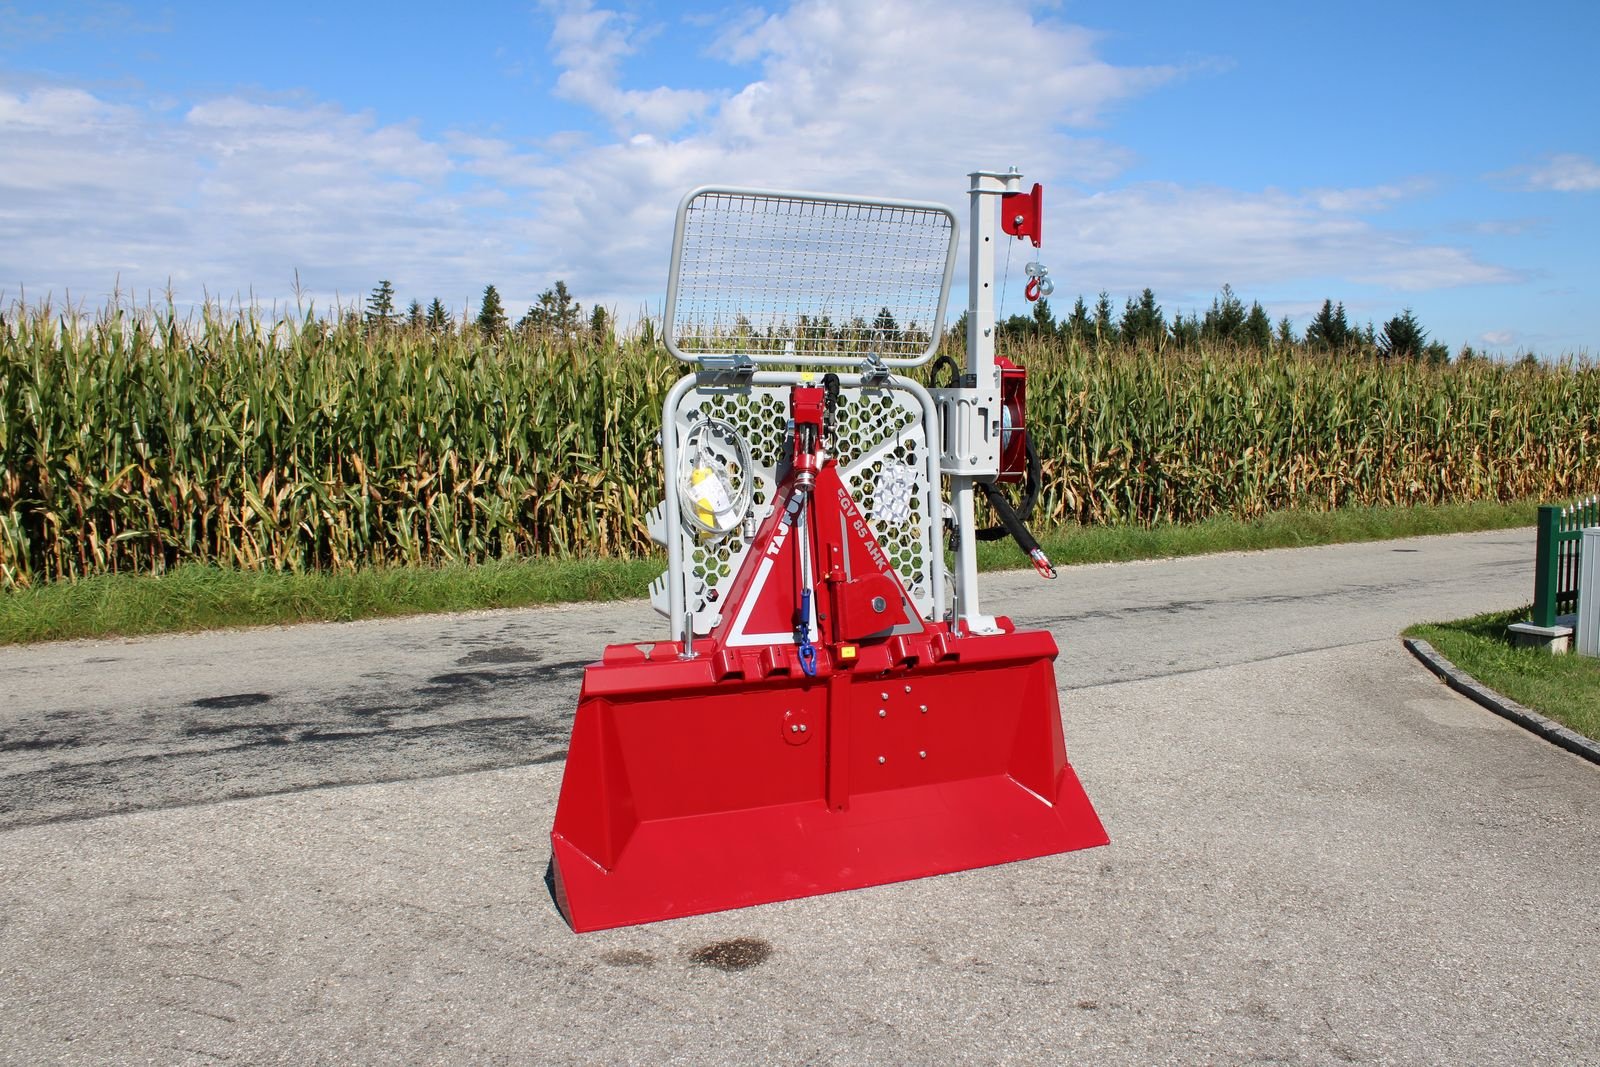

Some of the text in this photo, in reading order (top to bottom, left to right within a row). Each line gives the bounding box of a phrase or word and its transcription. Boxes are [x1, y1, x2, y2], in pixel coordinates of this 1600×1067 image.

[837, 488, 887, 570] EGV 85 AHK
